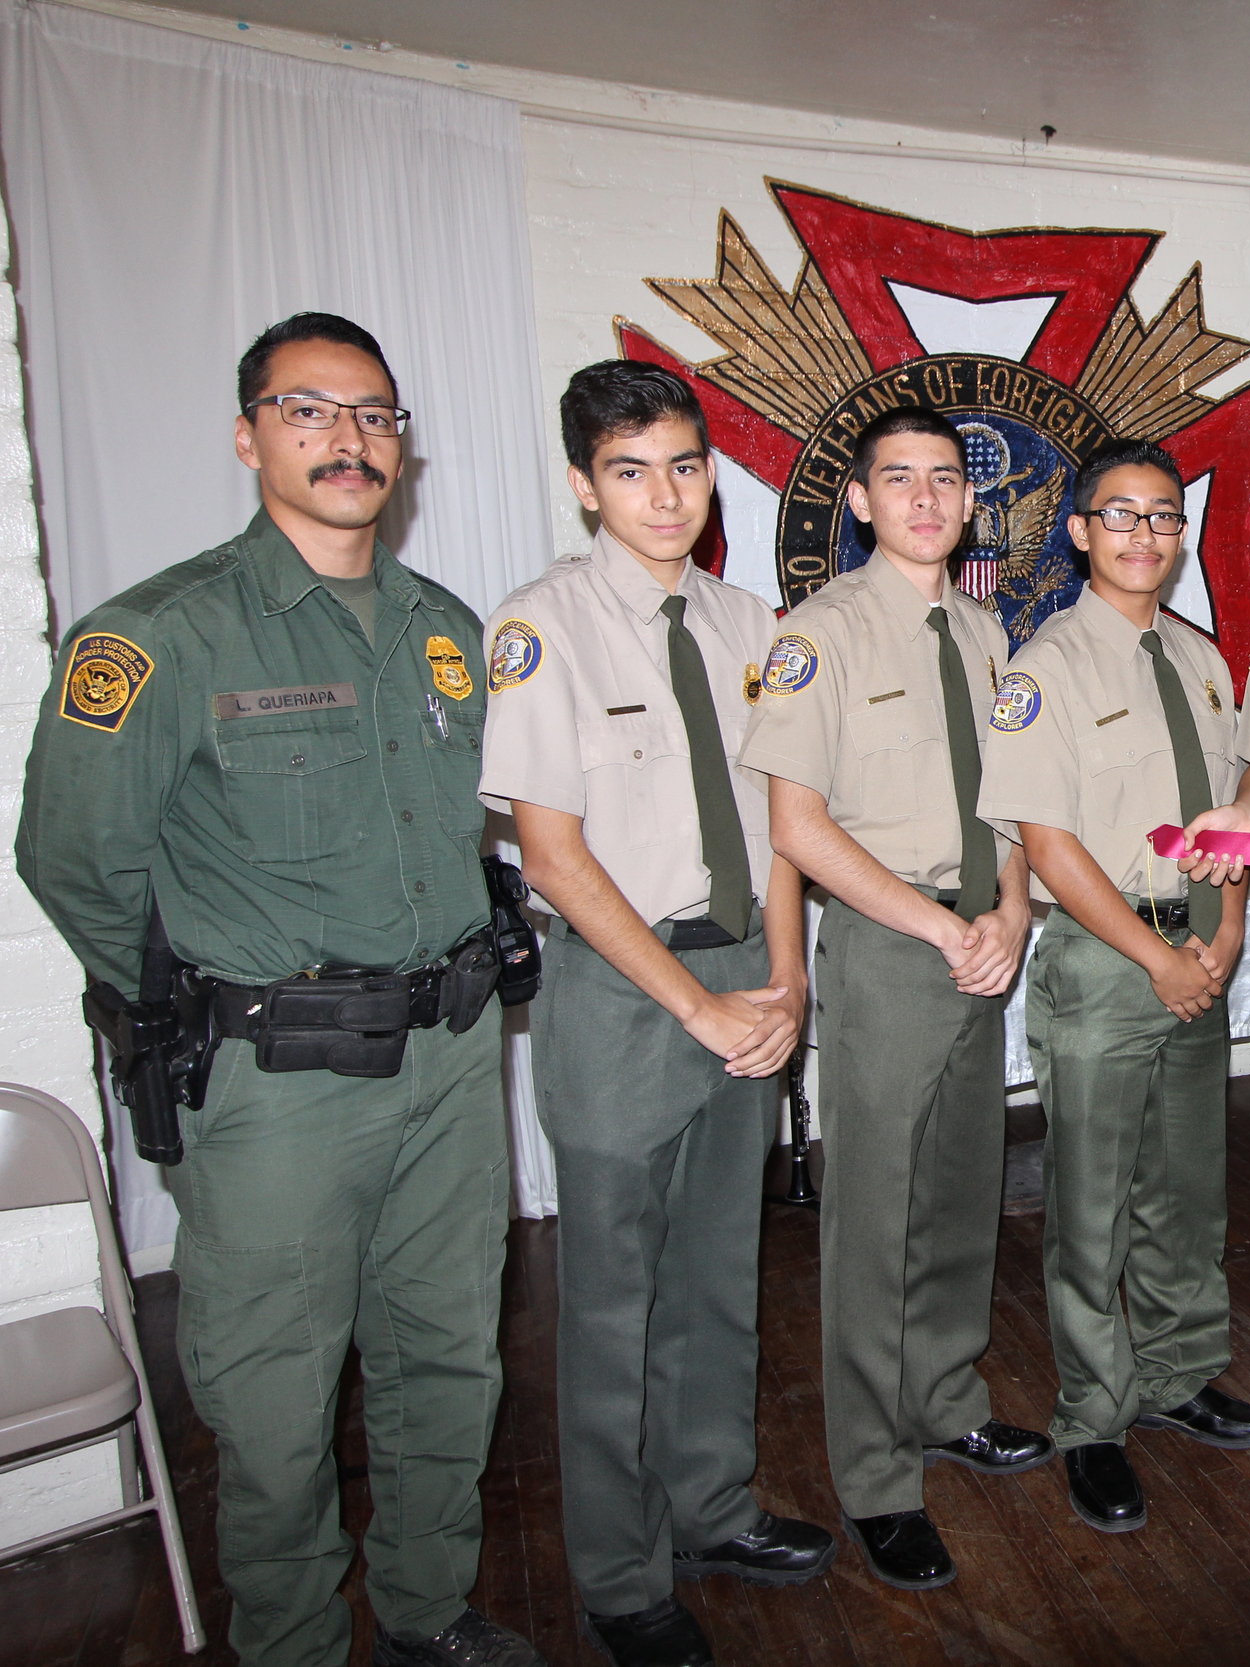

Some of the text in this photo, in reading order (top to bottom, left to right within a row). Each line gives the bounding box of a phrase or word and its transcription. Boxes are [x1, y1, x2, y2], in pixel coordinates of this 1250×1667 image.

[793, 363, 1098, 505] VETERANS OF FOREIGN
[103, 640, 138, 661] CUSTOMS
[75, 648, 142, 683] BORDER PROTECTION
[1005, 674, 1039, 693] ENFORCEMENT
[236, 690, 337, 712] L. QUERIAPA
[992, 720, 1024, 730] EXPLORER
